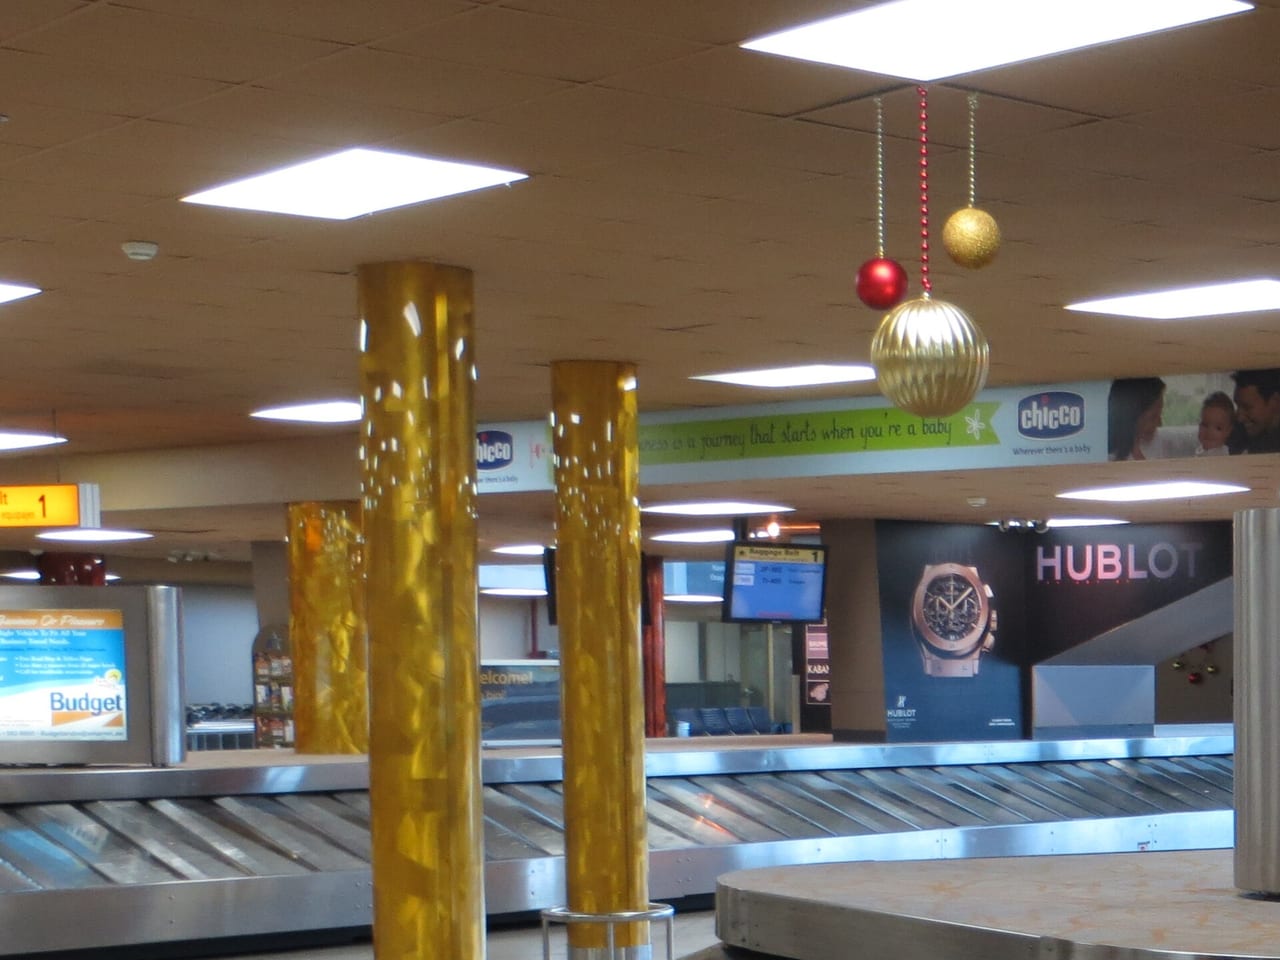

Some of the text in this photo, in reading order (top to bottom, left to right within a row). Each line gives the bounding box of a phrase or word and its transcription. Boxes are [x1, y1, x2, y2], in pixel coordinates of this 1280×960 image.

[1021, 395, 1080, 430] chicco
[822, 418, 854, 441] when
[908, 423, 917, 436] a
[922, 418, 951, 446] baby
[477, 434, 511, 463] hicco
[38, 494, 47, 518] 1
[811, 551, 818, 563] 1
[1036, 543, 1202, 581] HUBLOT
[480, 671, 533, 685] elcome!
[50, 692, 122, 716] Budget
